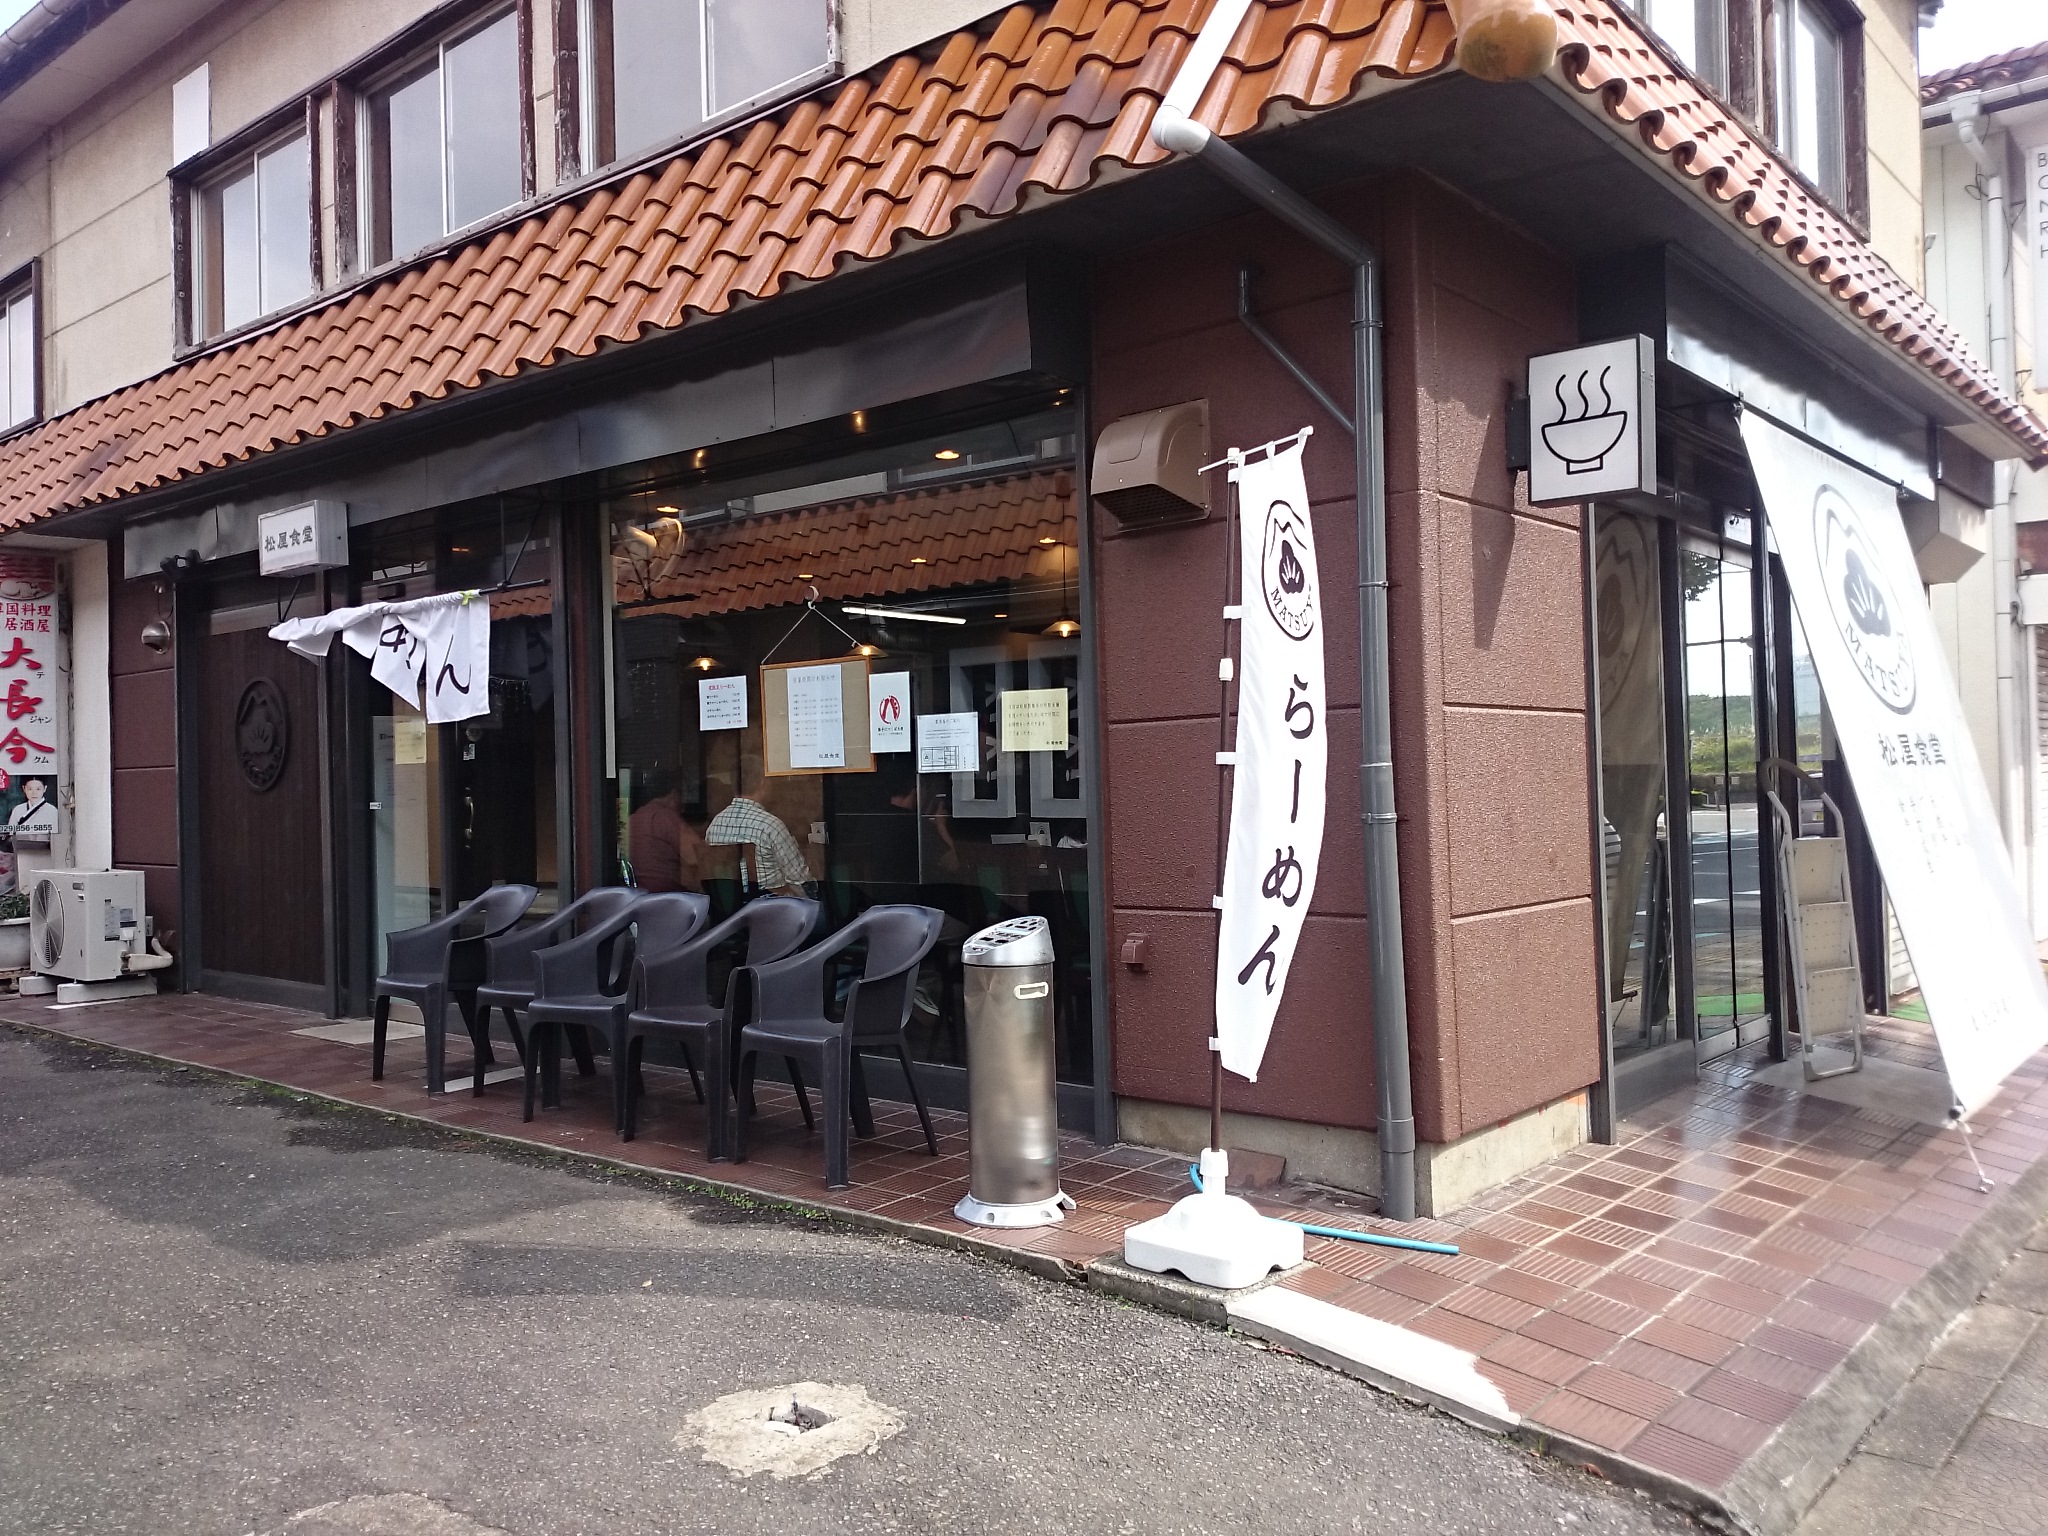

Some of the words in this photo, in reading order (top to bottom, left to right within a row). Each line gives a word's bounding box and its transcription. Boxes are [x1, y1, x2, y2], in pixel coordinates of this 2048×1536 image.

[264, 525, 314, 552] 松屋食堂
[0, 602, 52, 617] 国料理
[5, 617, 50, 633] 居酒屋
[36, 671, 45, 679] テ
[0, 637, 55, 763] 大長今
[29, 715, 53, 724] ジャン
[1877, 733, 1947, 768] 松屋食堂
[1238, 674, 1315, 997] らーめん
